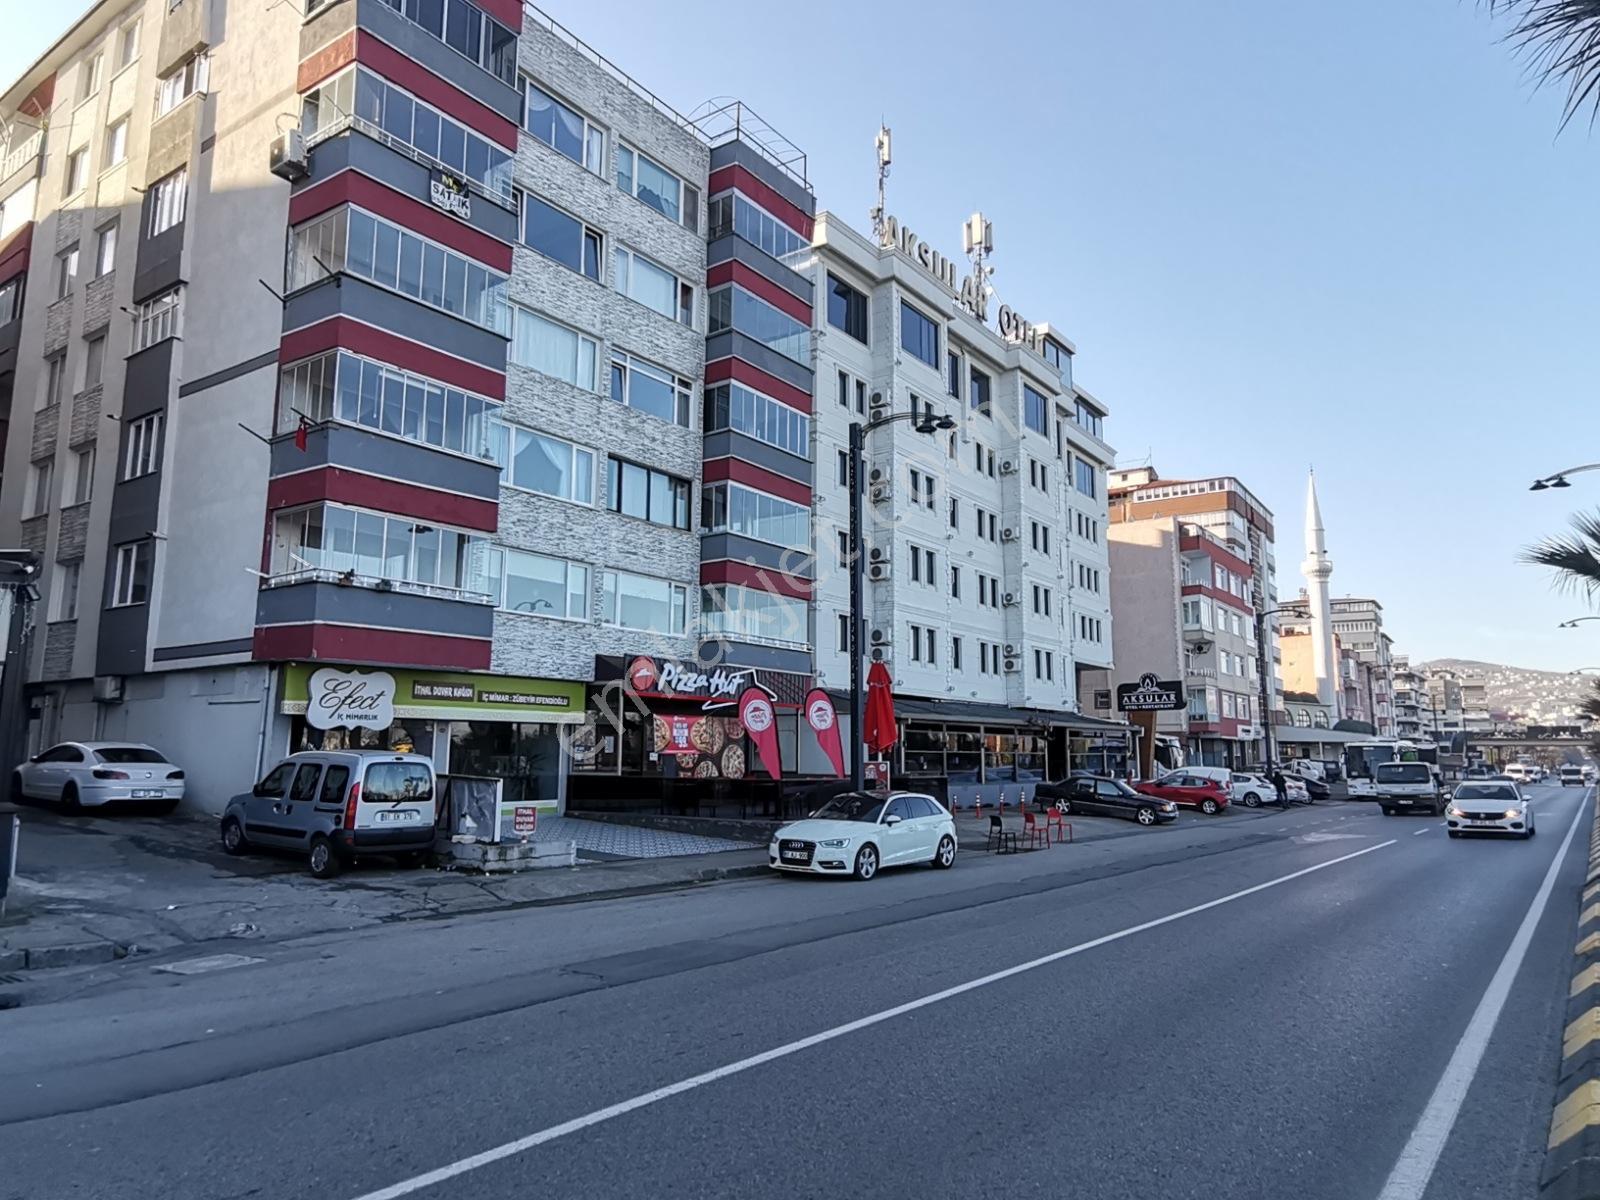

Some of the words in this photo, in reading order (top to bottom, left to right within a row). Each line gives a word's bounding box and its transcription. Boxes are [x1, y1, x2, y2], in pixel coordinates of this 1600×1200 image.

[432, 183, 469, 210] SATIK
[657, 662, 709, 692] Pizza
[709, 669, 745, 697] Hut
[319, 678, 386, 719] Efect
[1122, 693, 1177, 703] AKSULAR
[346, 713, 378, 721] MİMARLIK
